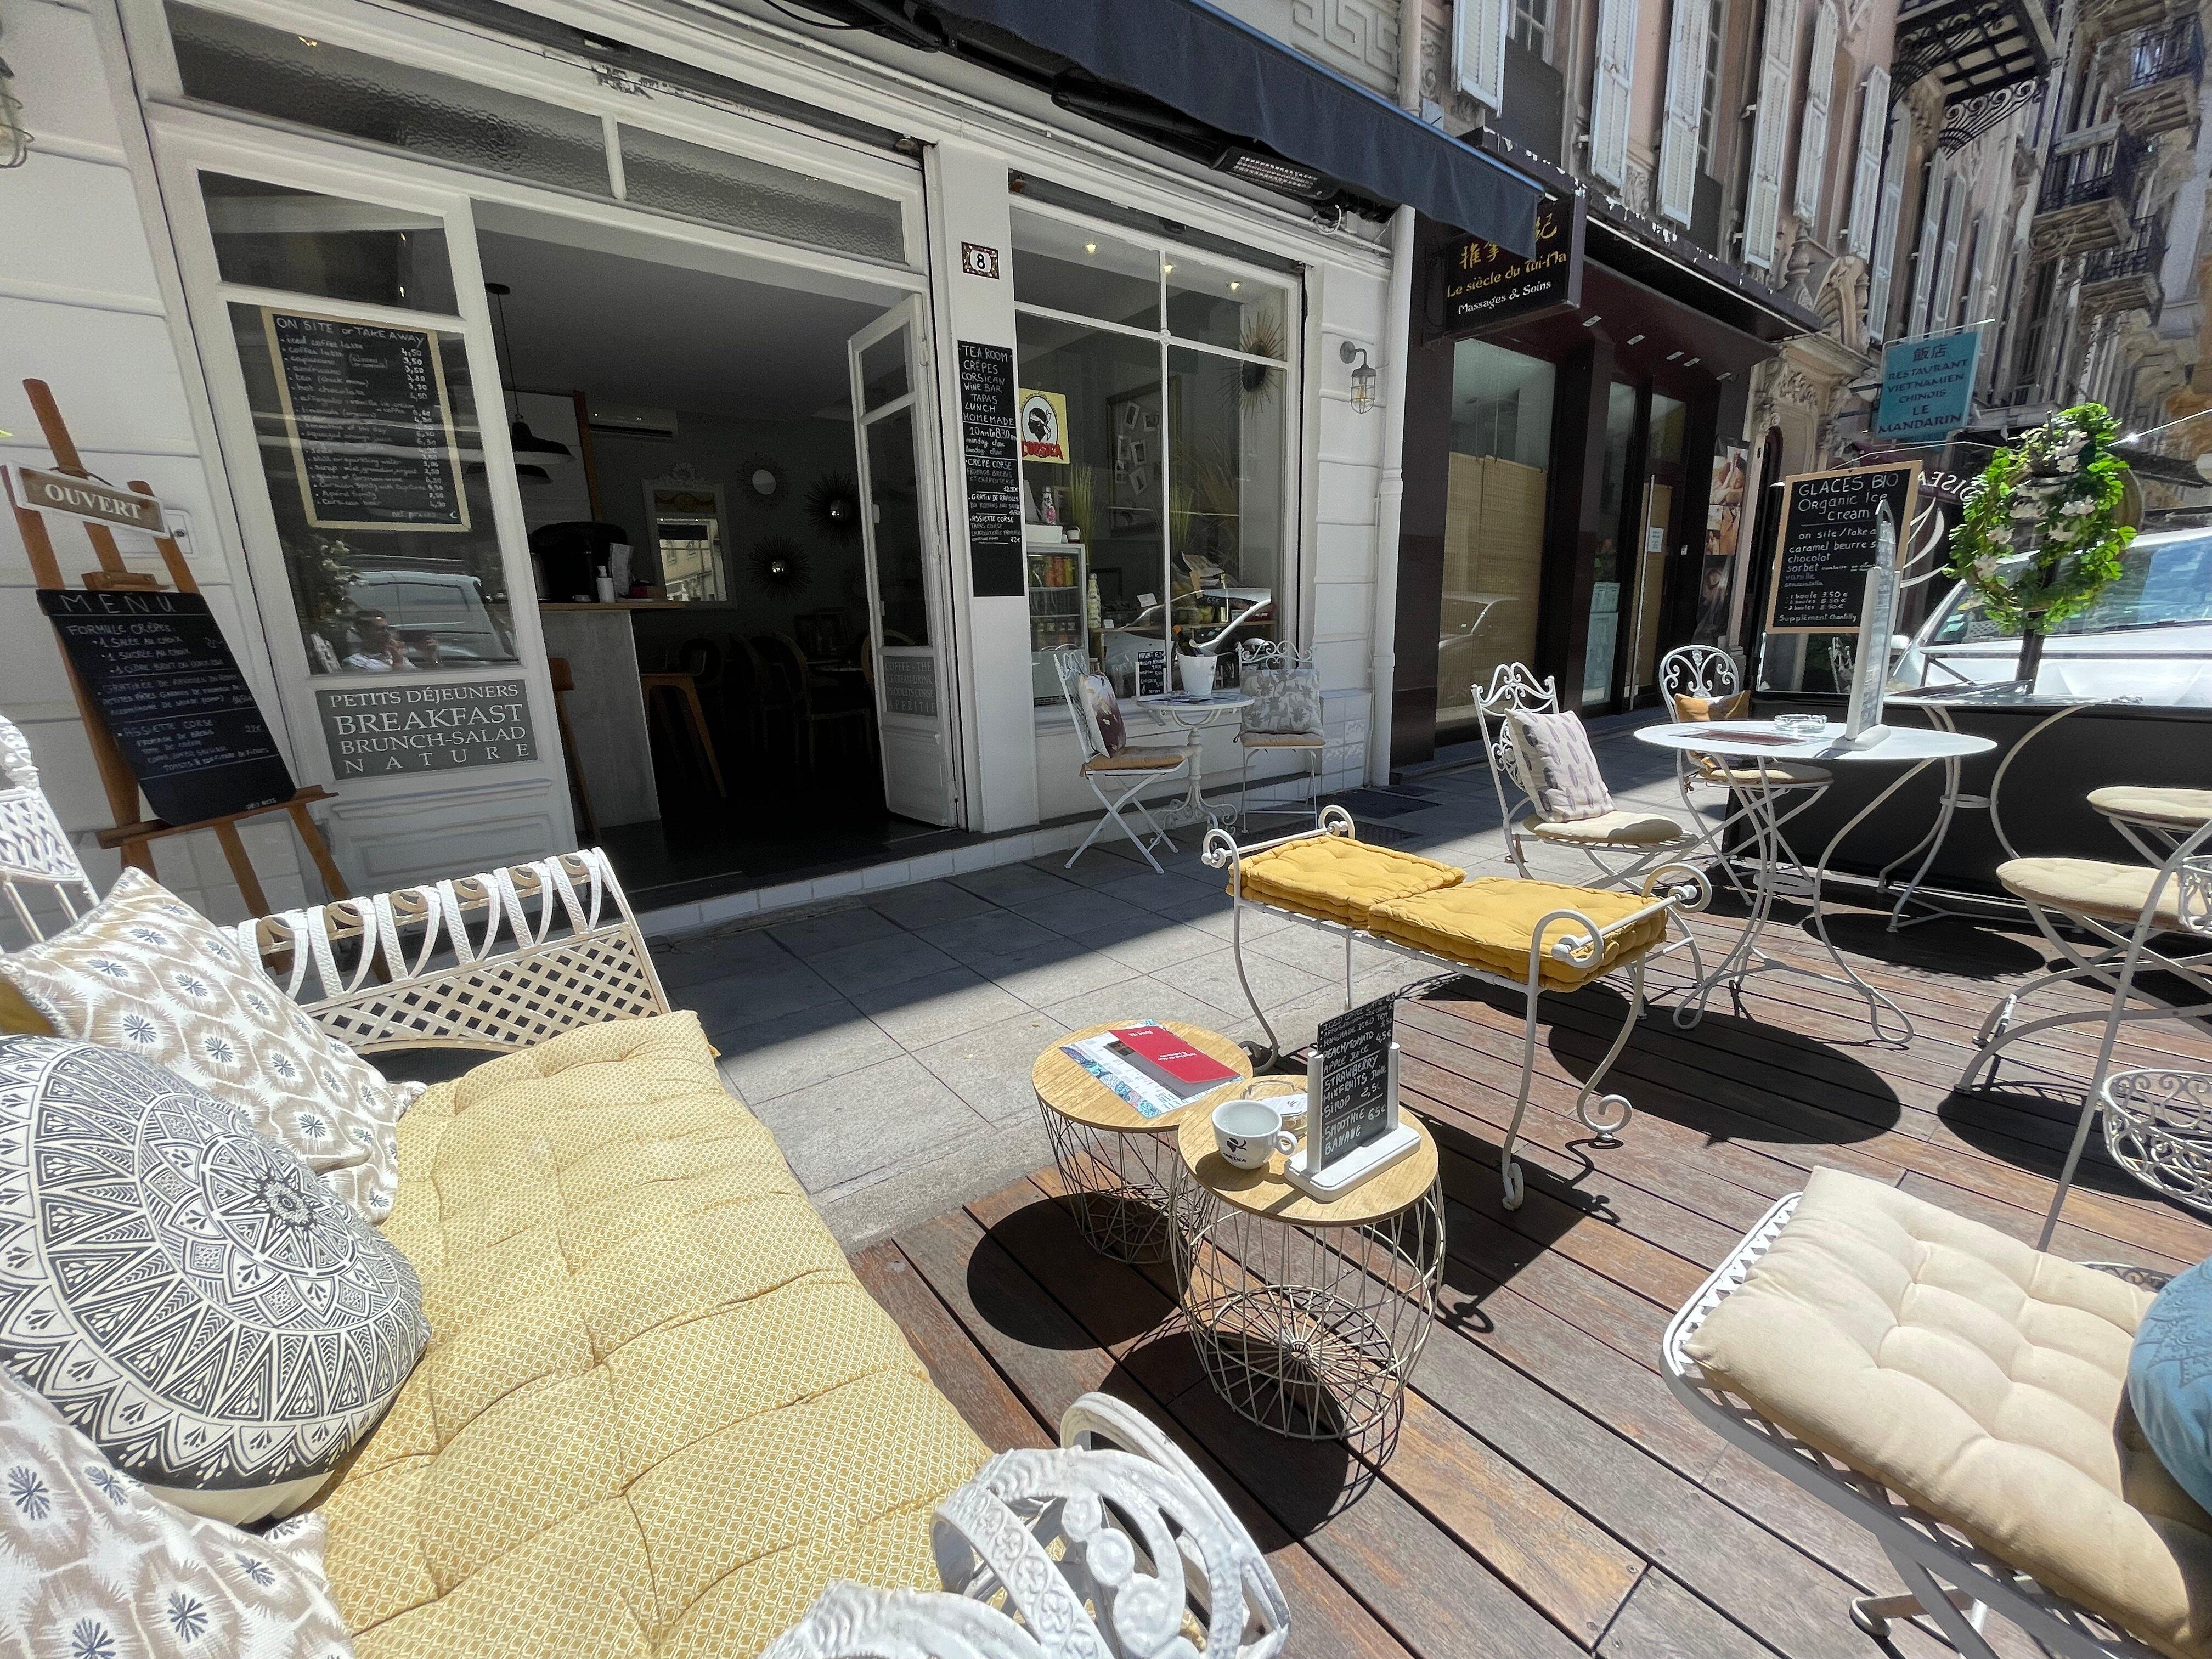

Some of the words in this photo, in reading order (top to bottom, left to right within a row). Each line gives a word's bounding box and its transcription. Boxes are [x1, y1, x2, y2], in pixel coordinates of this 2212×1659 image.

[977, 253, 985, 270] 8
[1447, 285, 1463, 298] Le
[1466, 272, 1502, 290] siècle
[1505, 265, 1521, 279] du
[1458, 294, 1506, 314] Massages
[1509, 289, 1520, 300] &
[1523, 280, 1551, 296] Soins
[276, 317, 298, 330] ON
[303, 320, 335, 334] SITE
[962, 345, 982, 359] TEA
[985, 348, 1008, 363] ROOM
[1888, 358, 1969, 380] RESTAURANT
[961, 371, 1006, 386] CORSICAN
[963, 382, 982, 391] WINE
[984, 383, 1003, 393] BAR
[1887, 374, 1965, 393] VIETNAMIEN
[970, 393, 998, 405] TAPAS
[1899, 389, 1946, 404] CHINOIS
[964, 401, 996, 413] LUNCH
[1912, 404, 1930, 416] LE
[963, 413, 1015, 426] HOMEMADE
[1878, 413, 1962, 434] MANDARIN
[1798, 476, 1864, 496] GLACES
[1871, 472, 1899, 489] BIO
[44, 483, 142, 520] OUVERT
[1816, 528, 1838, 539] site
[1788, 540, 1829, 554] caramel
[1833, 540, 1867, 551] beurre
[1788, 552, 1831, 563] chocolat
[1786, 562, 1820, 572] sorbet
[60, 594, 176, 614] MENU
[66, 624, 127, 636] FORMULE
[330, 691, 402, 708] PETITS
[406, 684, 518, 704] DÉJEUNERS
[123, 722, 176, 737] ASSIETTE
[183, 719, 214, 730] CORSE
[333, 703, 523, 736] BREAKFAST
[340, 726, 526, 755] BRUNCH-SALAD
[1324, 1054, 1378, 1092] STRAWBERRY
[1324, 1124, 1361, 1156] BANANE
